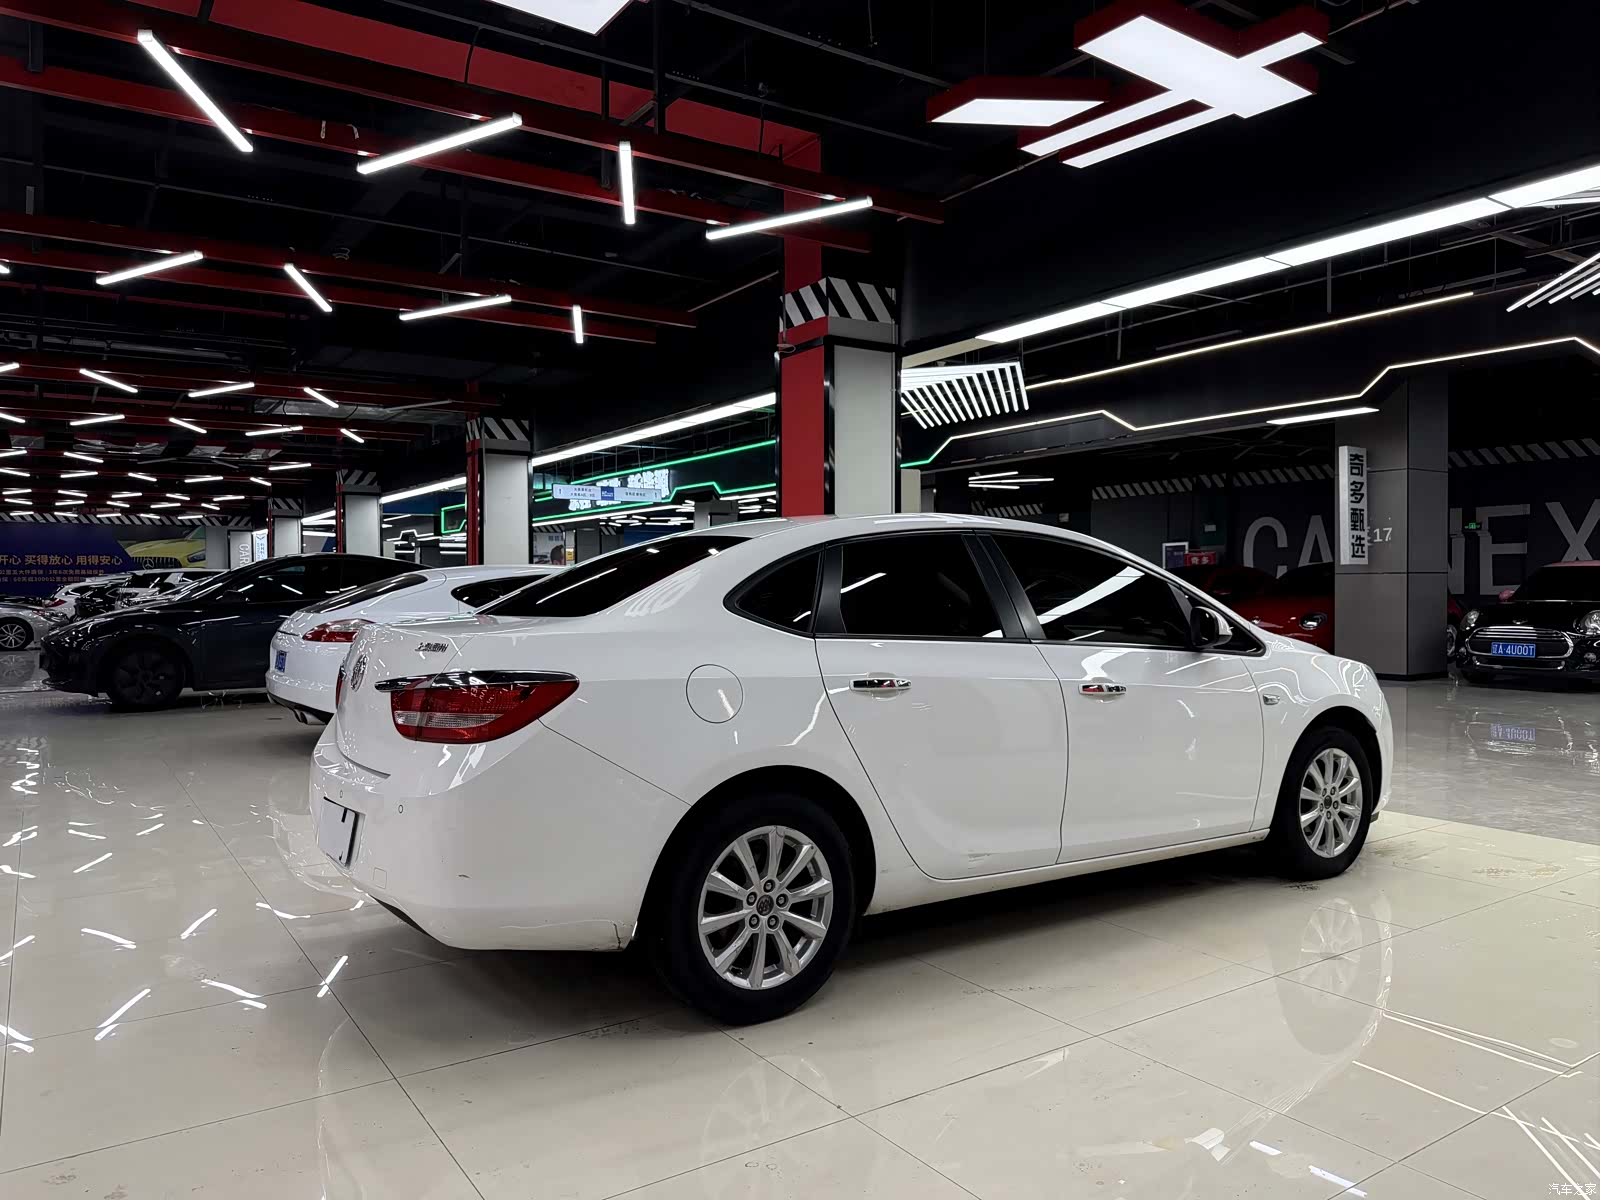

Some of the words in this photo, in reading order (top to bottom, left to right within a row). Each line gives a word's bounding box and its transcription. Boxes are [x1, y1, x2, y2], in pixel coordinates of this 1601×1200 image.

[1349, 453, 1365, 558] 奇多甄选
[25, 554, 73, 565] 买得放心
[76, 555, 122, 566] 用得安心
